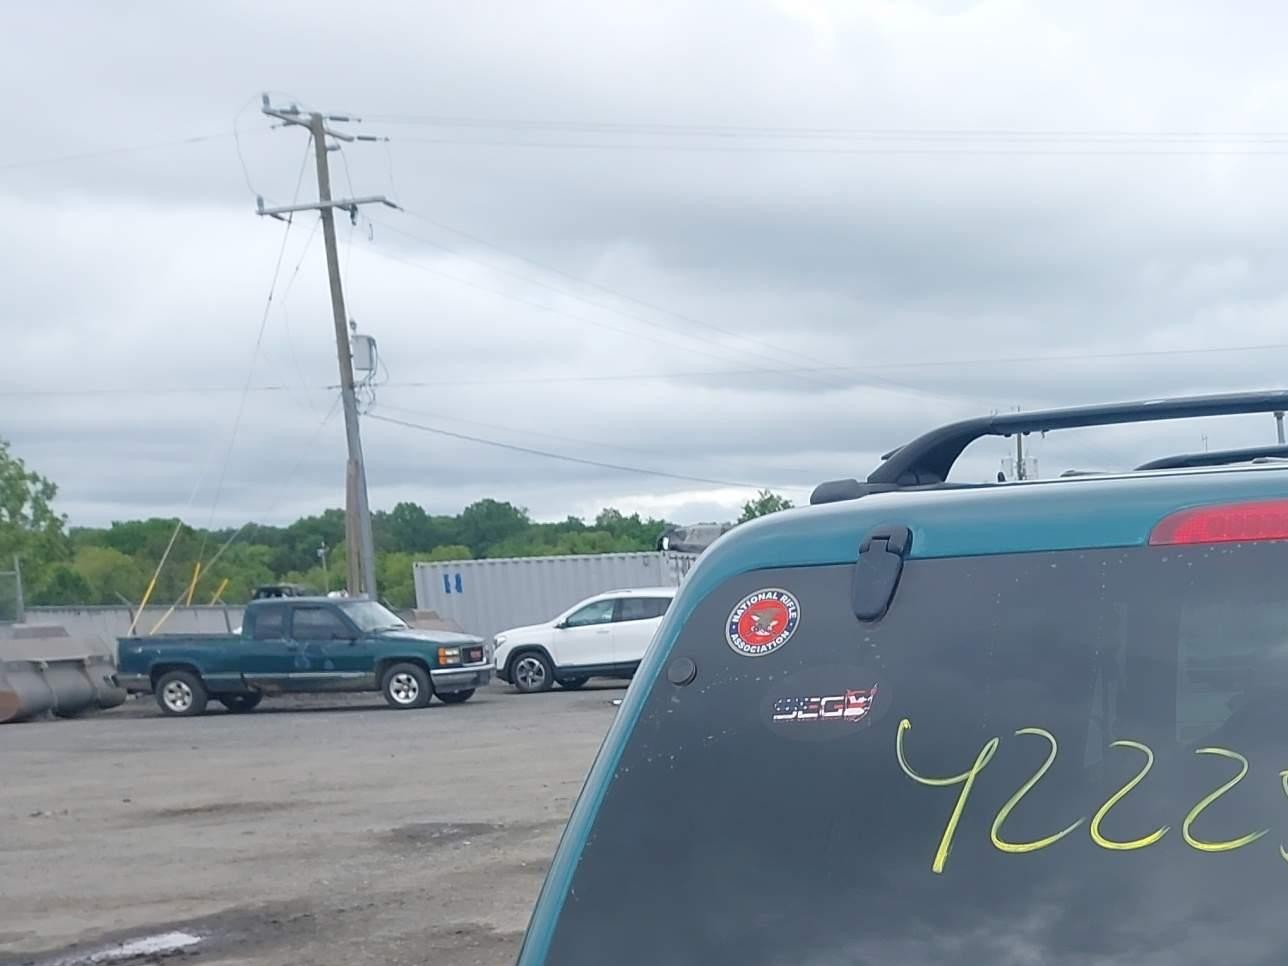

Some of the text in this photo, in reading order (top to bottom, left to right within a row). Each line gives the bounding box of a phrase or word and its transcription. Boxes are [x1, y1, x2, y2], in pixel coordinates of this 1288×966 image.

[732, 591, 797, 623] NATIONAL RIFLE
[731, 630, 790, 653] ASSOCIATION
